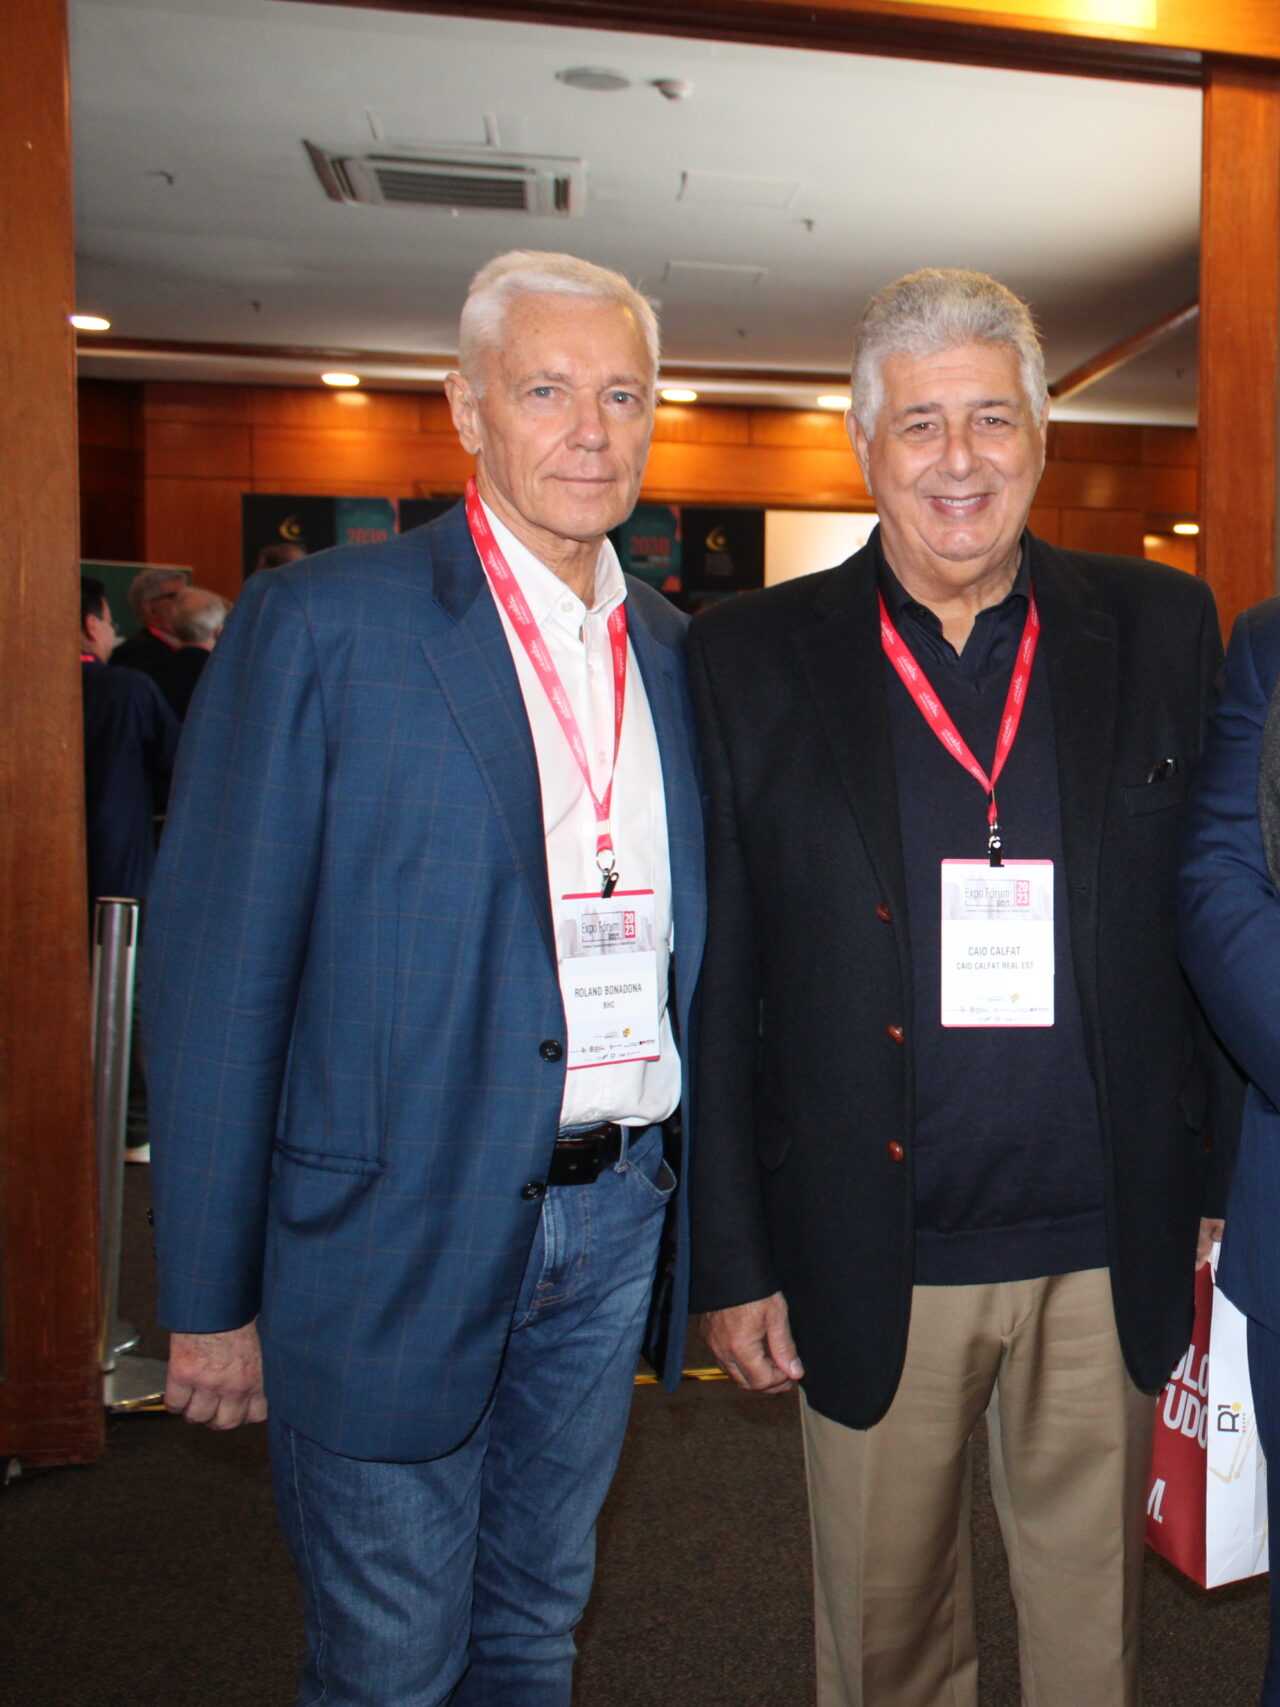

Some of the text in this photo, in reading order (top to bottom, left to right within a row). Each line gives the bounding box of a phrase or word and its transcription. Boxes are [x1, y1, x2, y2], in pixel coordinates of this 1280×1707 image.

[968, 946, 1021, 956] CAIO CALFAT
[956, 962, 972, 970] CAIO
[974, 962, 1000, 970] CALFAT
[575, 984, 642, 998] ROLAND BONADONA
[1156, 1383, 1208, 1449] UDO
